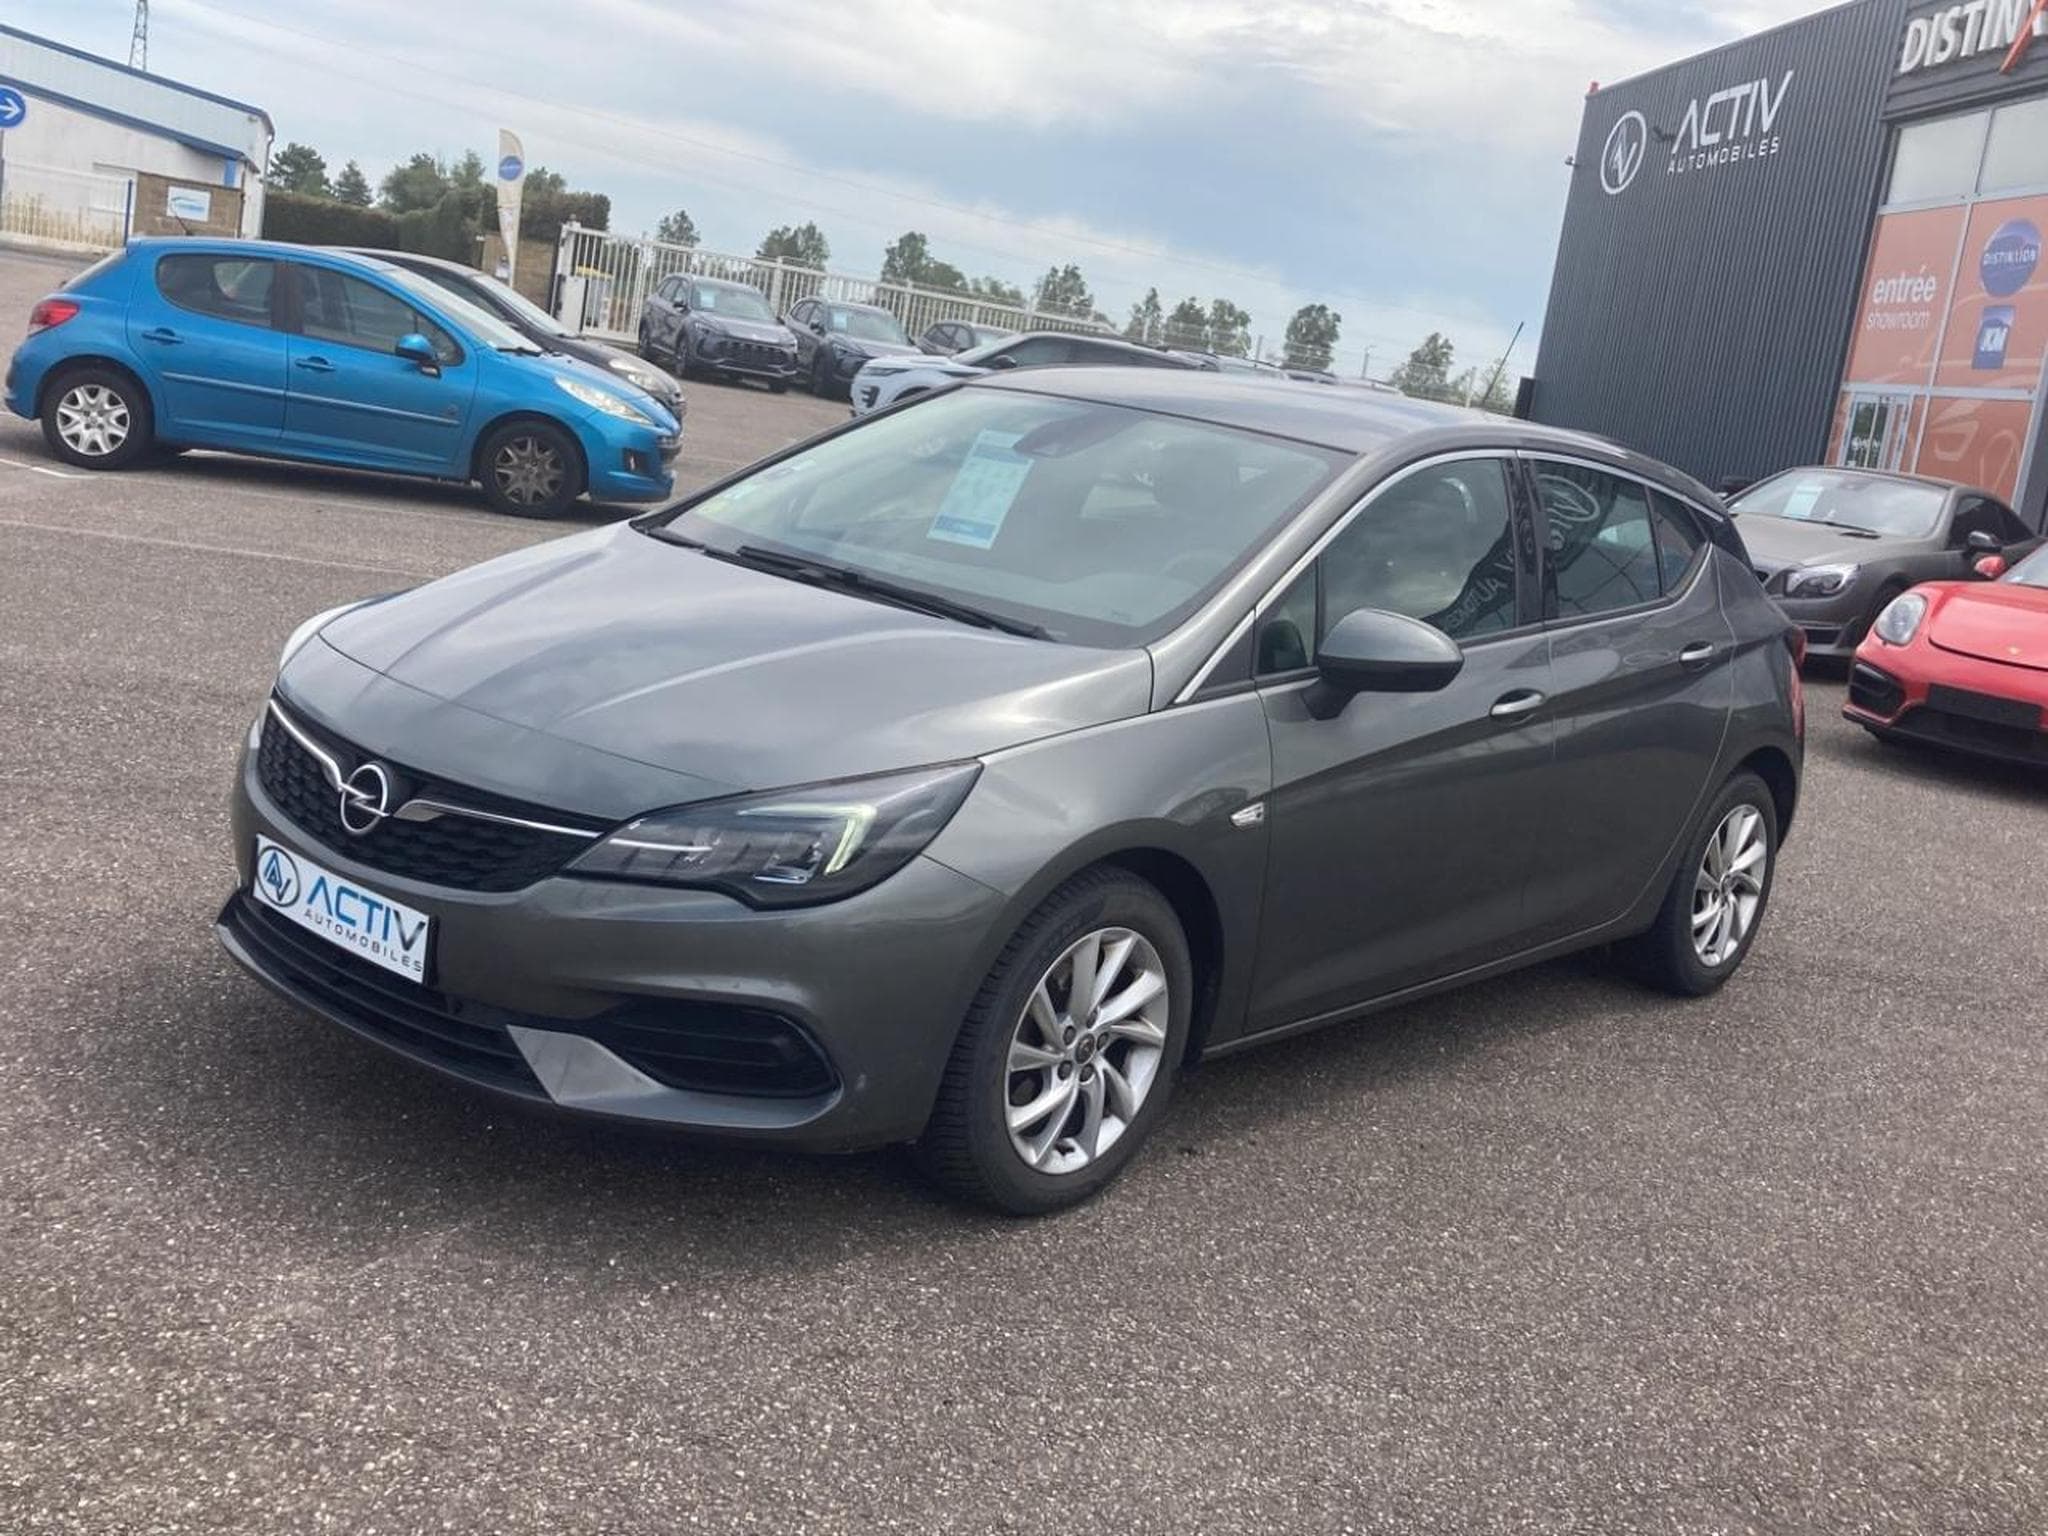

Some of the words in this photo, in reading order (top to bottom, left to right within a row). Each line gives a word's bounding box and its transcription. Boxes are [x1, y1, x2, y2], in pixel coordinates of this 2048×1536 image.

[1671, 70, 1794, 155] ACTIV
[1666, 136, 1780, 176] AUTOMOBILES
[1872, 264, 1937, 304] entrée
[1866, 308, 1931, 331] showroom
[306, 875, 427, 951] ACTIV
[303, 908, 424, 973] AUTOMOBILES
